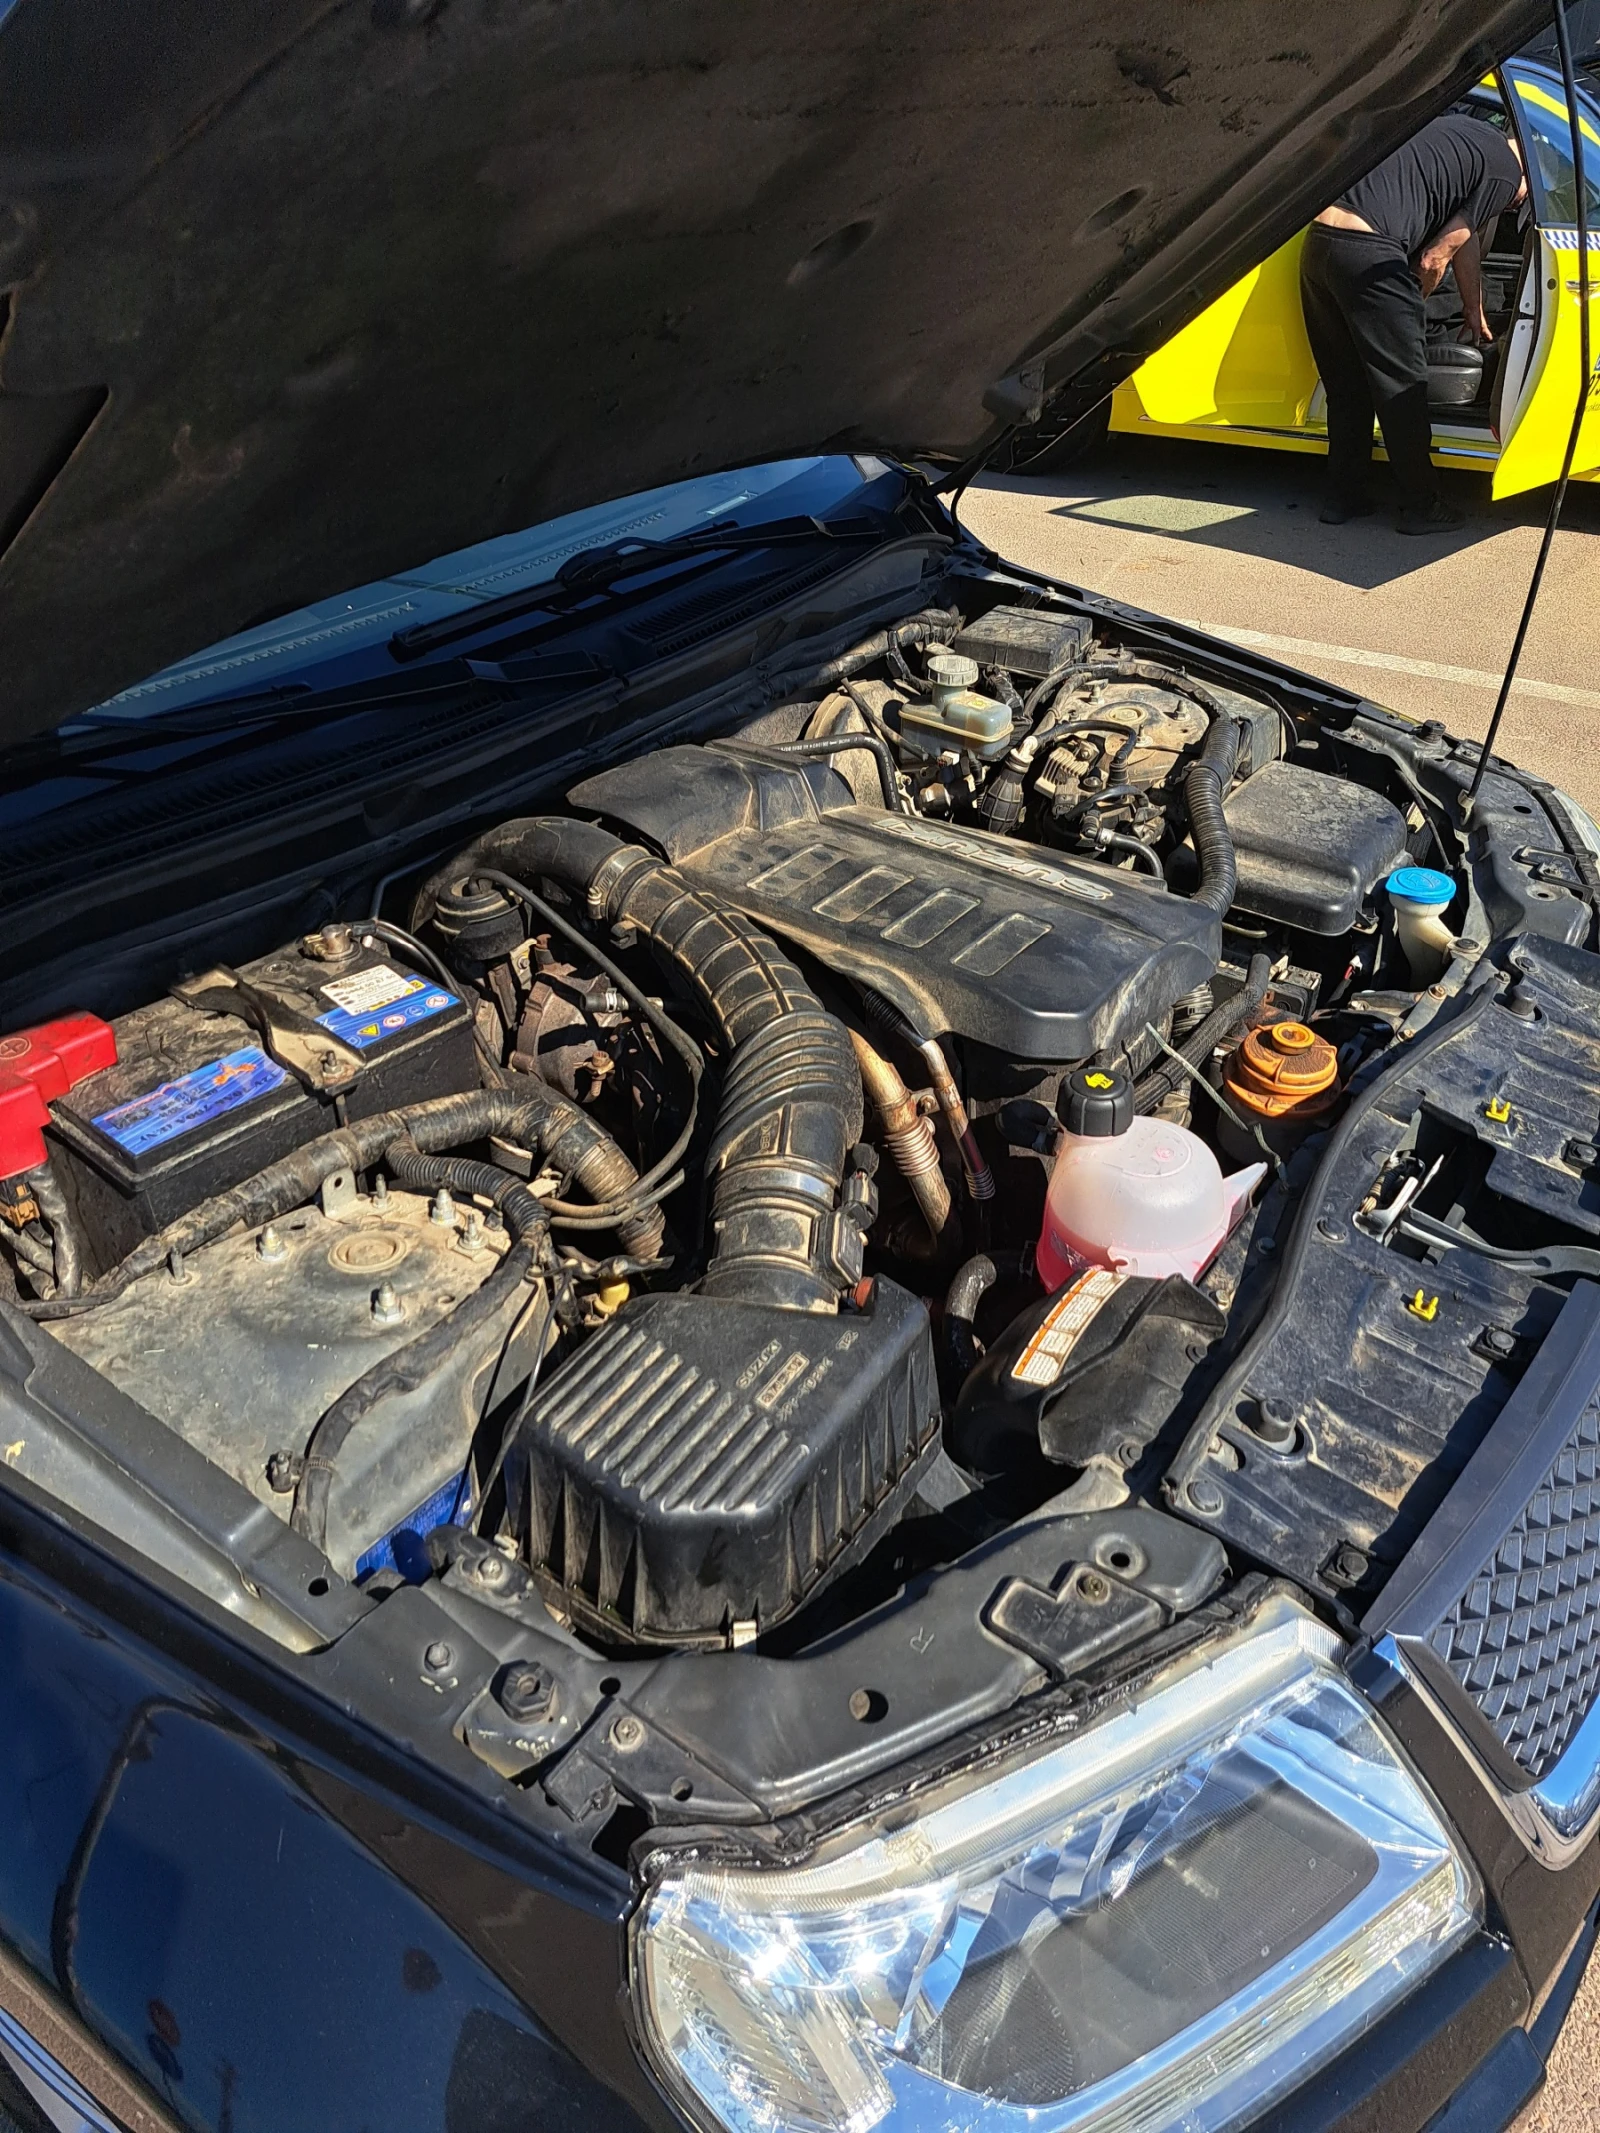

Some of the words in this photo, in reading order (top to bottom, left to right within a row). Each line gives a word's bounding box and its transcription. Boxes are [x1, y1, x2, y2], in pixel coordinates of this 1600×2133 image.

[870, 818, 1114, 900] SUZUKI
[736, 1339, 782, 1389] SUZUKI
[910, 1625, 935, 1654] R
